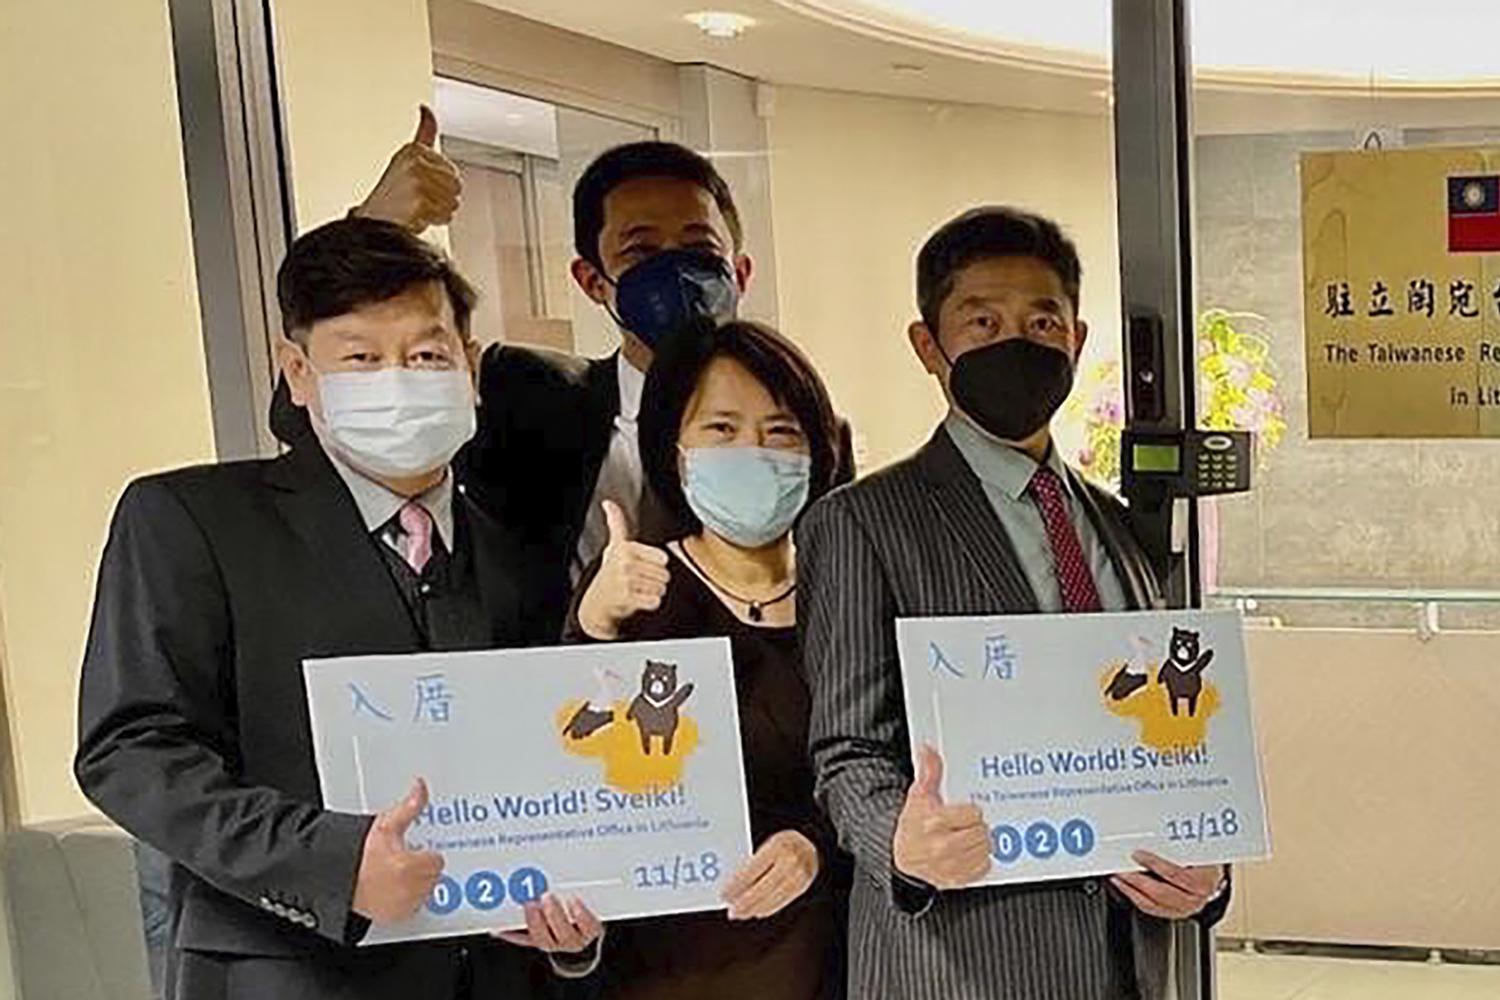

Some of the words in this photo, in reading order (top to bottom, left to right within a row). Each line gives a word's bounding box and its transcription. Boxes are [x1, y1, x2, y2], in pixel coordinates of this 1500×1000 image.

[1326, 344, 1358, 363] The
[1368, 342, 1465, 362] Taiwanese
[1450, 386, 1468, 405] in
[930, 634, 1016, 679] 入厝
[348, 673, 454, 723] 入厝
[982, 753, 1044, 779] Hello
[1048, 745, 1126, 774] World!
[1133, 744, 1209, 770] Sveiki!
[415, 799, 489, 827] Hello
[494, 790, 588, 820] World!
[594, 784, 686, 813] Sveiki!
[997, 825, 1085, 857] 021
[1167, 808, 1239, 843] 11/18
[431, 874, 538, 908] 021
[634, 852, 721, 890] 11/18
